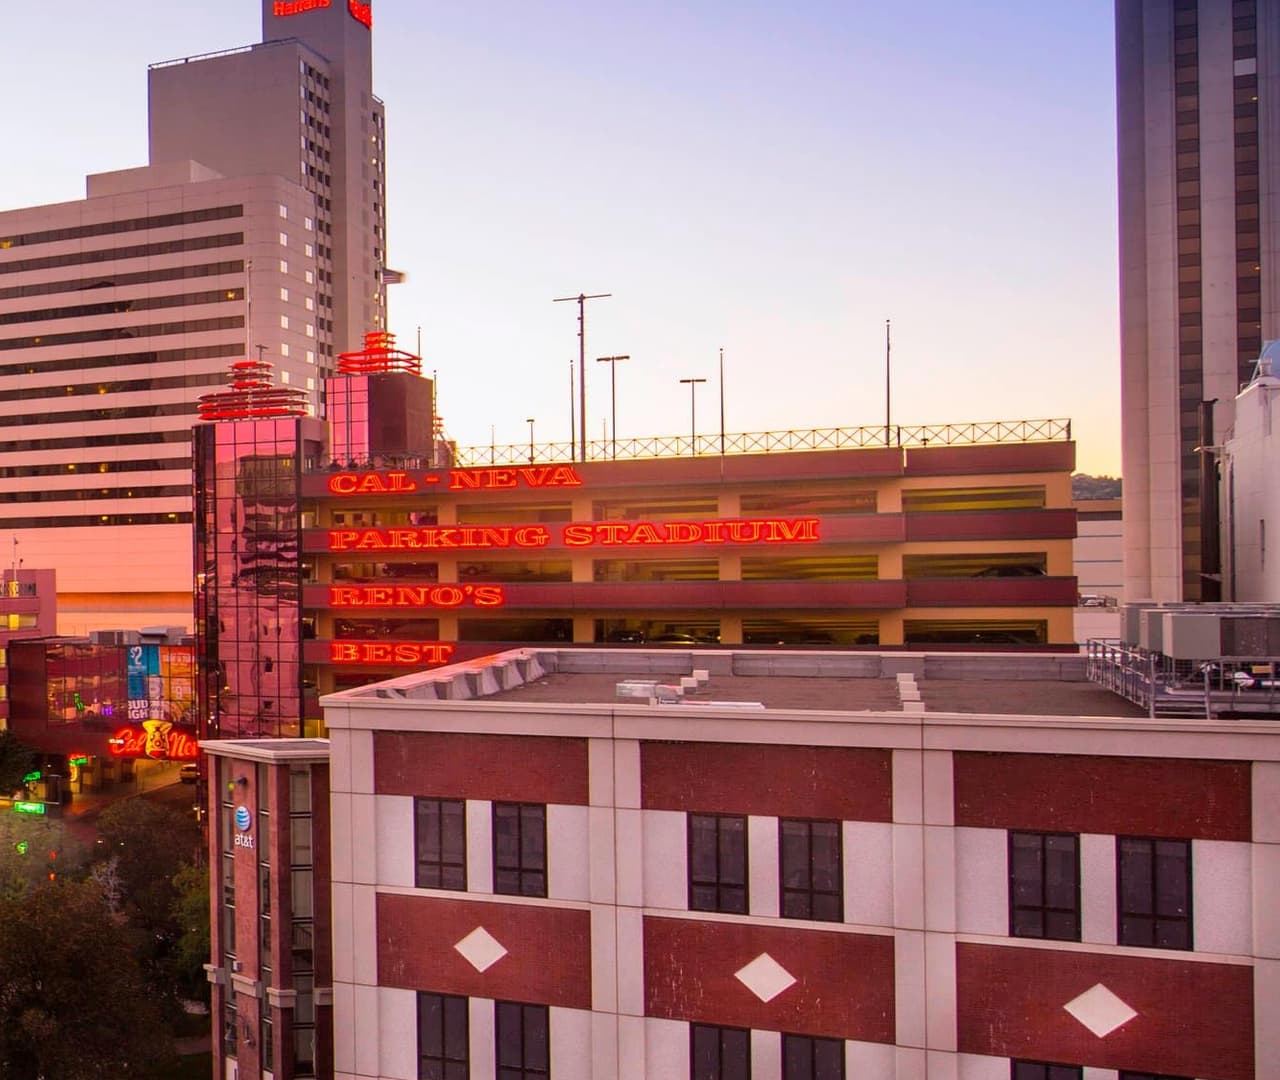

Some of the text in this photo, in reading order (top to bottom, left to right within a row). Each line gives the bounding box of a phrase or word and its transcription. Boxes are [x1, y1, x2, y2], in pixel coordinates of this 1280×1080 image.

[329, 473, 417, 494] CAL
[450, 467, 582, 490] NEVA
[330, 519, 819, 549] PARKING STADIUM
[330, 586, 503, 606] RENO'S
[331, 644, 453, 664] BEST
[112, 729, 147, 753] Cal
[234, 833, 254, 849] at&t
